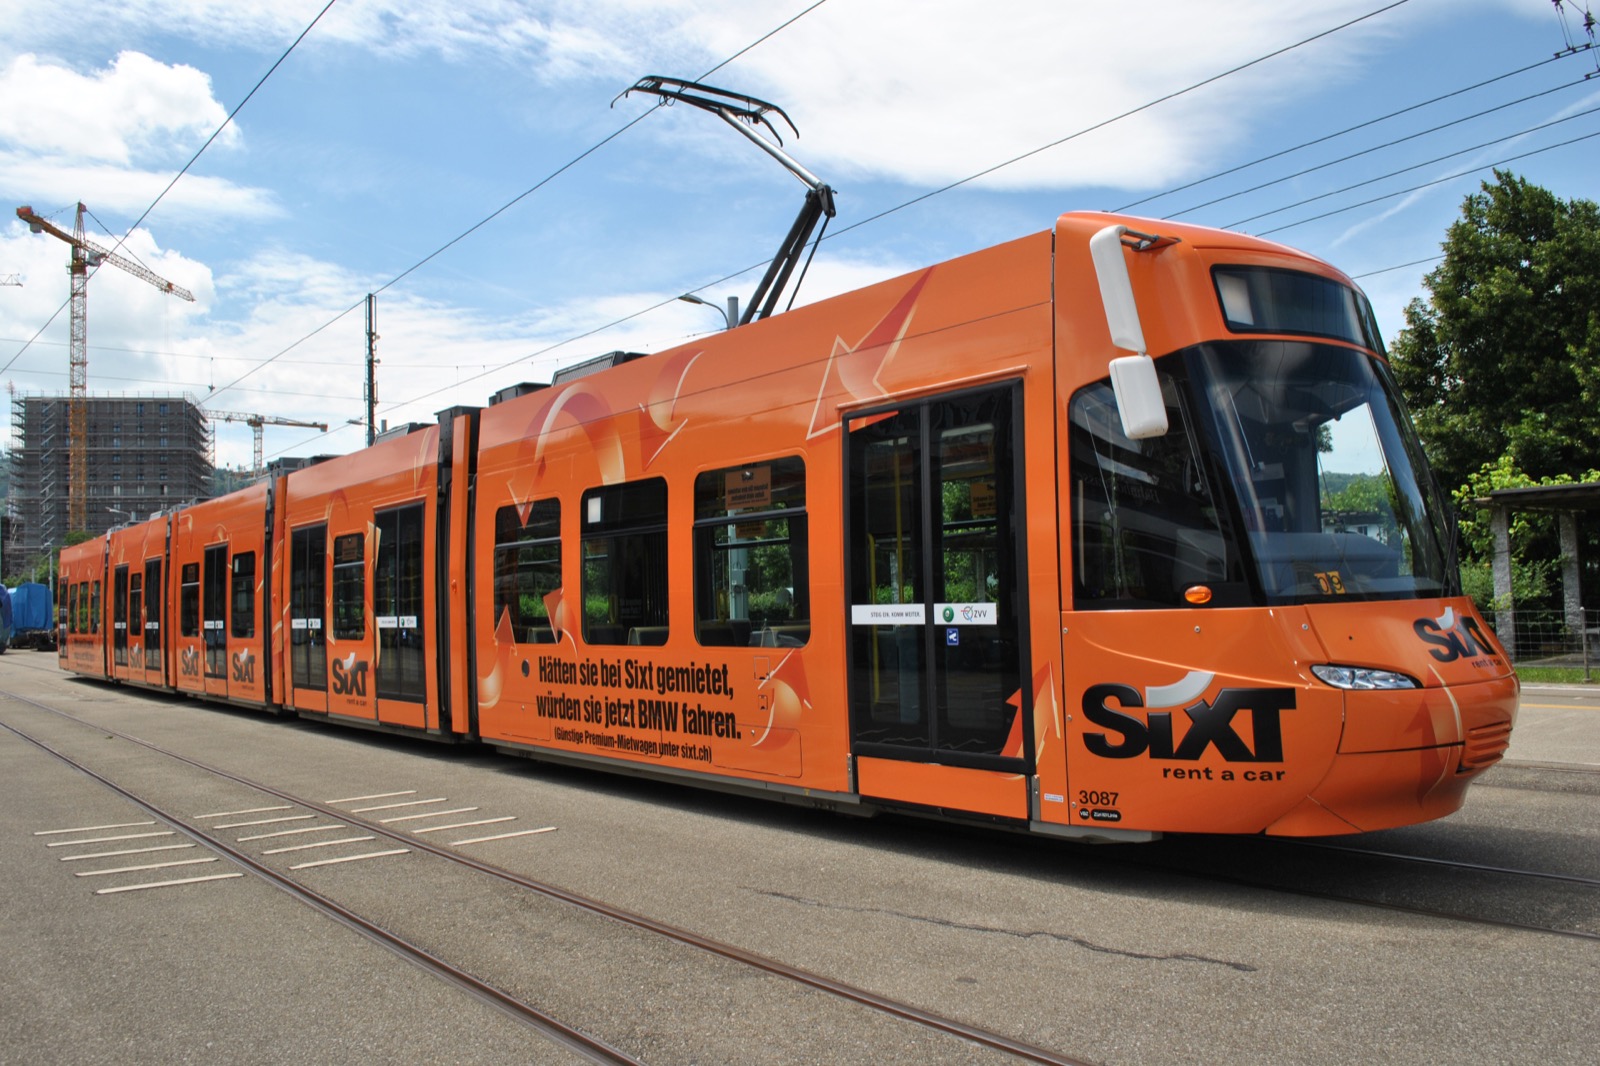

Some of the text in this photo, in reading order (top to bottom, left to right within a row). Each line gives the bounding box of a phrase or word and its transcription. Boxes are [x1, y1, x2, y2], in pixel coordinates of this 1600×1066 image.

[974, 610, 987, 618] ZVV
[539, 656, 734, 700] Hätten sie bei Sixt gemietet,
[536, 691, 742, 740] würden sie jetzt BMW fahren.
[554, 727, 712, 764] (Günstige Premium-Mietwagen unter sixt.ch)
[1163, 767, 1286, 782] rent a car
[1079, 790, 1119, 807] 3087
